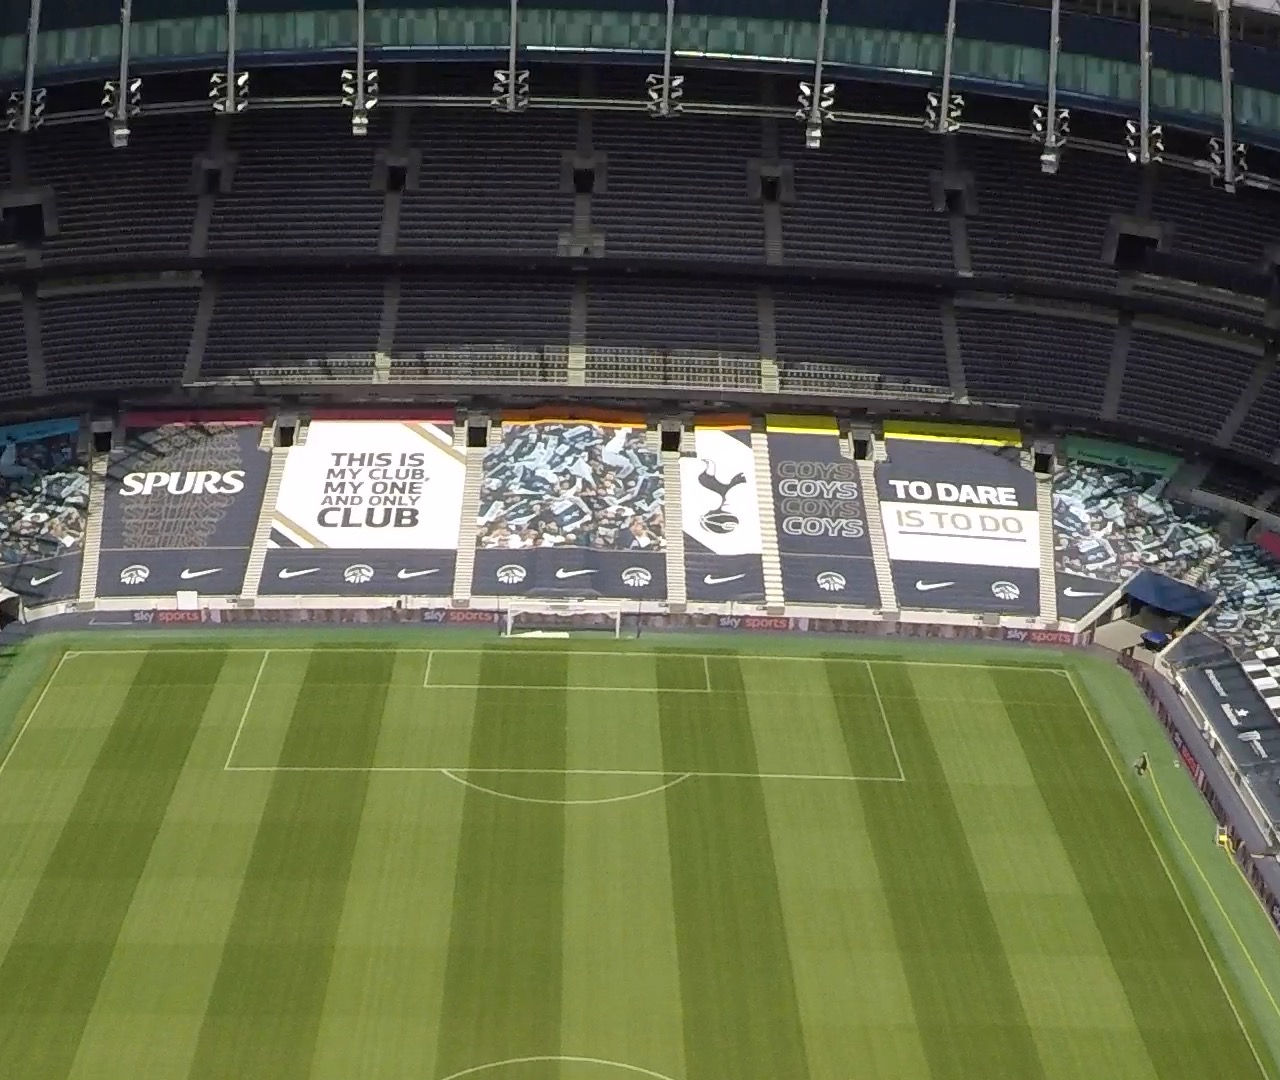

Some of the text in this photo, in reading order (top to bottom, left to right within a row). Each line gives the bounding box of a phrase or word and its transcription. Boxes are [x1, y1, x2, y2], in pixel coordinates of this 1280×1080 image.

[330, 452, 425, 467] THIS IS
[118, 470, 245, 496] SPURS
[326, 468, 431, 482] MY CLUB,
[323, 482, 422, 495] MY ONE
[778, 478, 858, 500] COYS
[889, 479, 1019, 507] TO DARE
[320, 495, 421, 507] AND ONLY
[317, 507, 420, 528] CLUB
[896, 509, 1023, 534] IS TO DO
[782, 516, 864, 538] COYS
[132, 611, 200, 624] sky sports
[745, 617, 787, 630] sports
